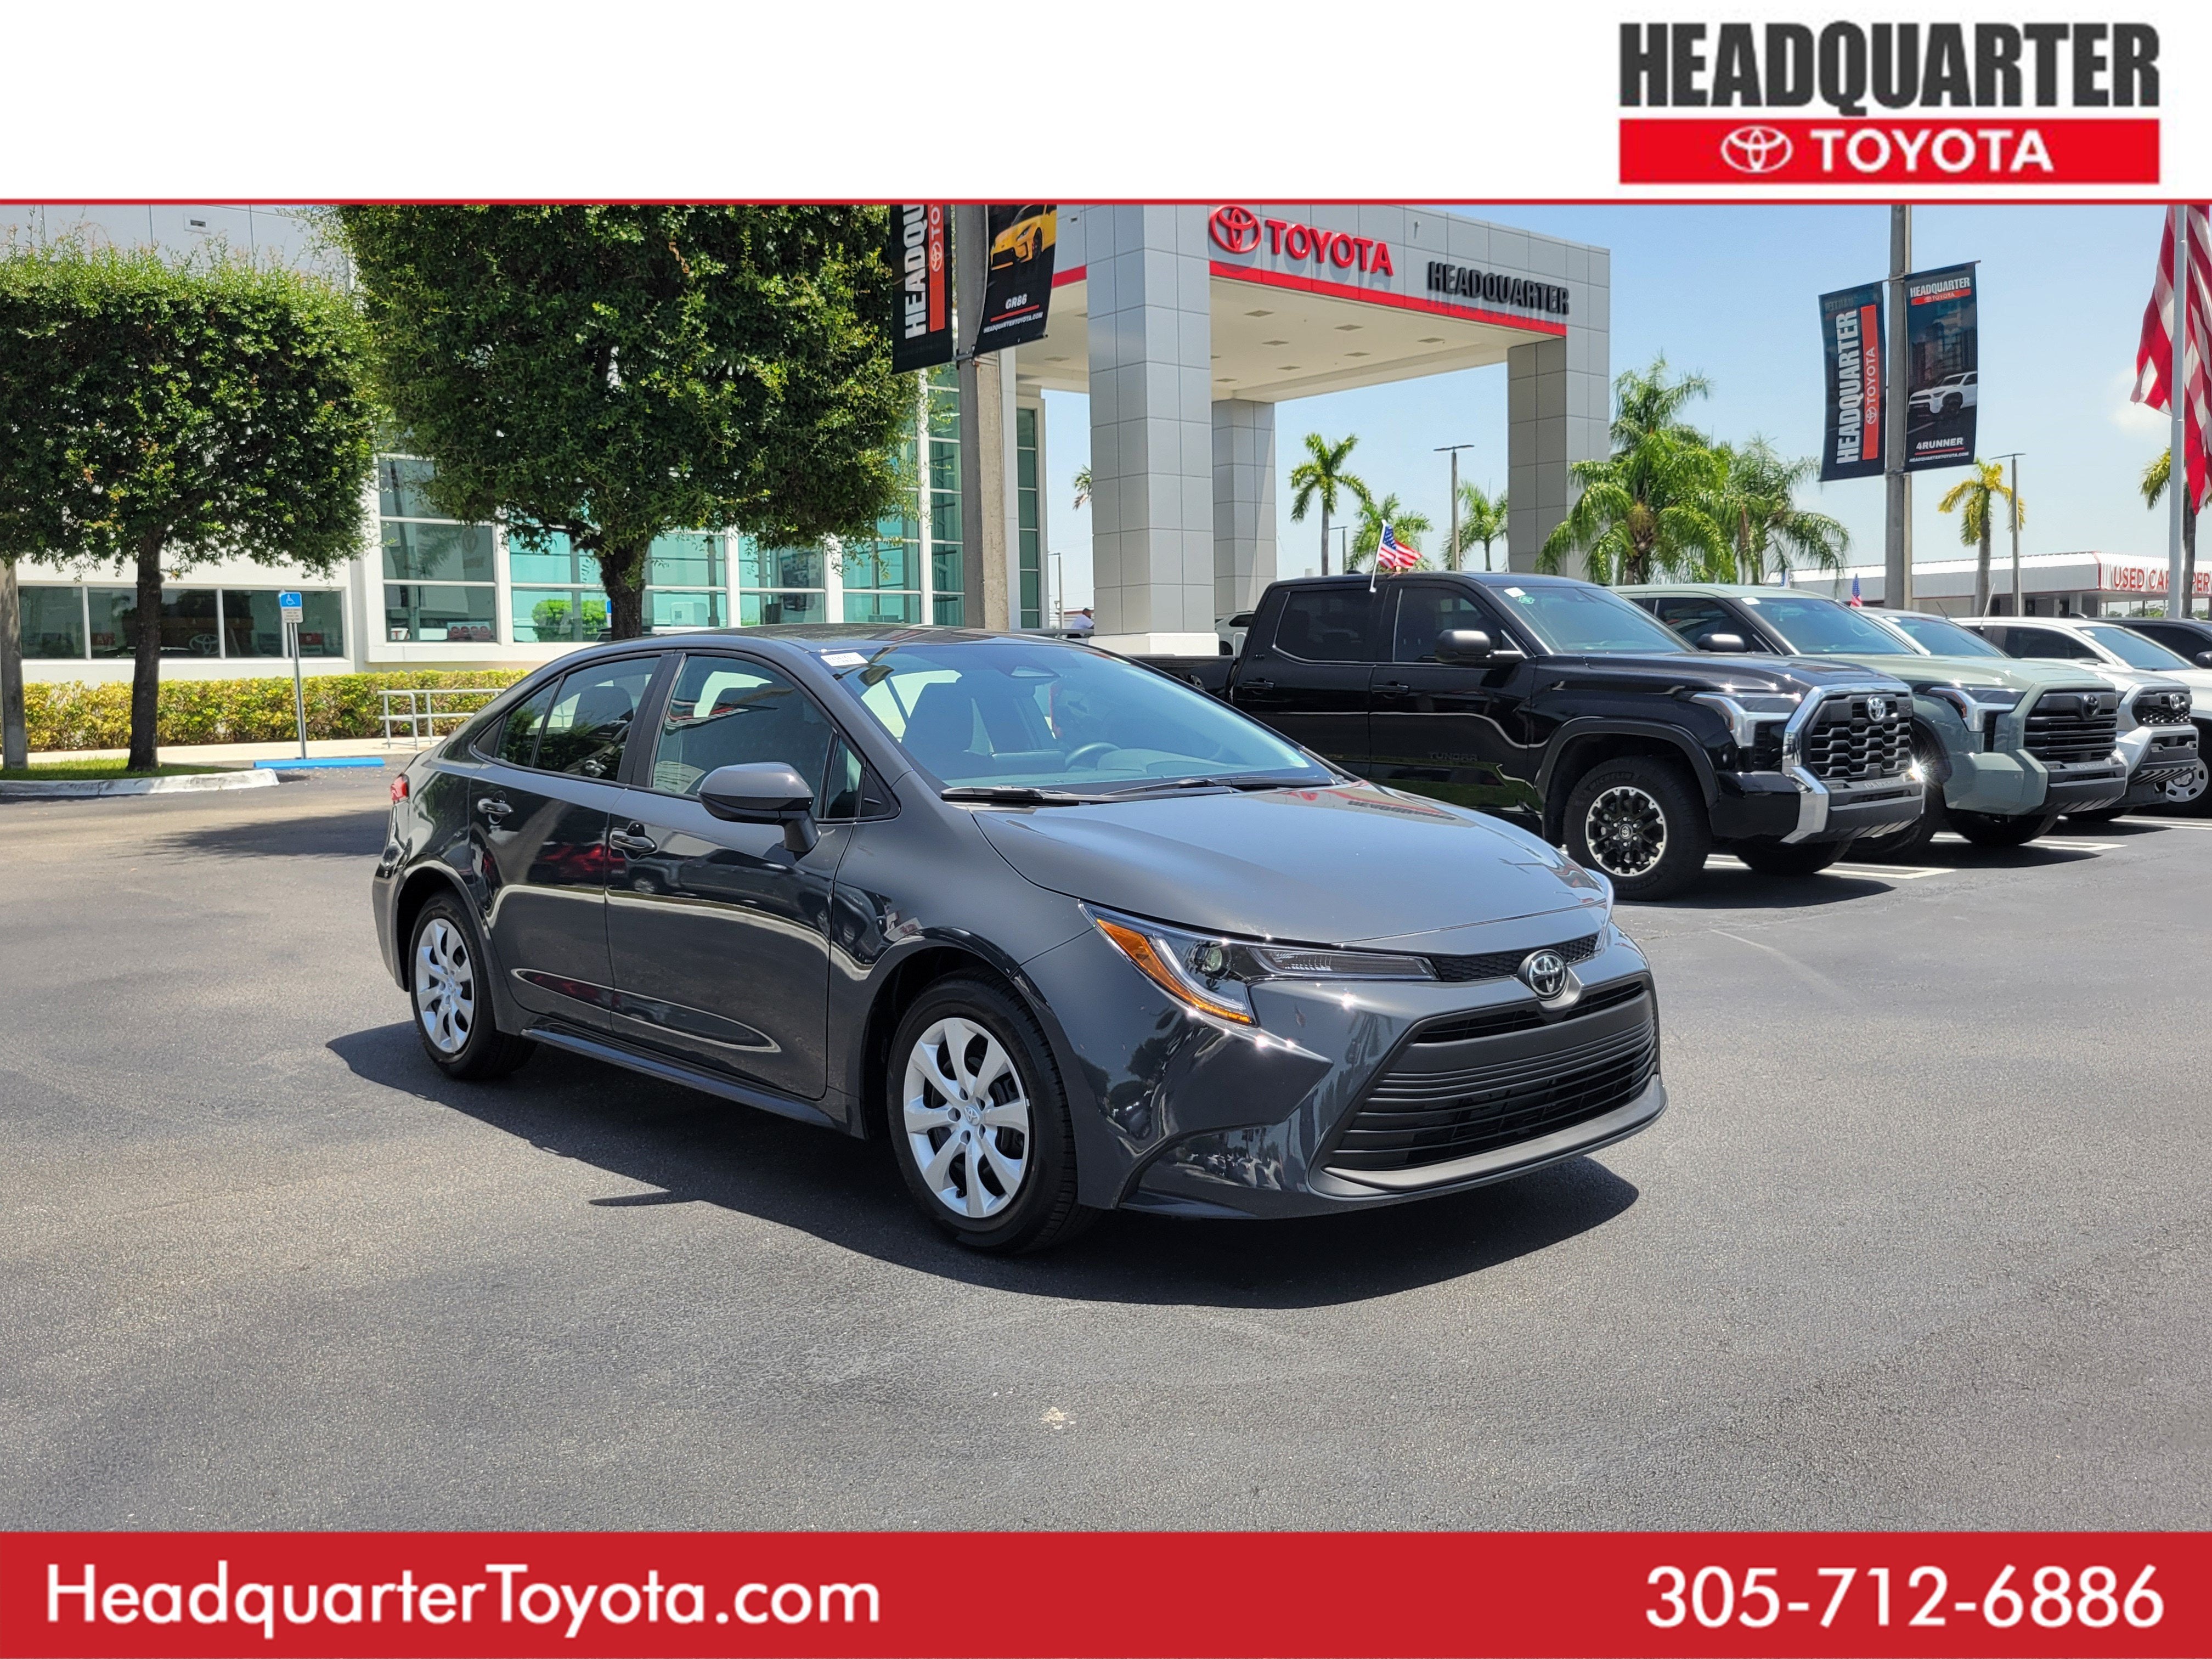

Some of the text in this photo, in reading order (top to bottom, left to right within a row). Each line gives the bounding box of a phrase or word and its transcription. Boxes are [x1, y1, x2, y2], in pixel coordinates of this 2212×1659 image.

[930, 205, 940, 241] TO
[1265, 219, 1394, 276] TOYOTA
[1427, 261, 1570, 315] HEADQUARTER
[1910, 276, 1971, 298] HEADQUARTER
[1932, 291, 1955, 300] TOYOTA
[983, 311, 1043, 334] HEADQUARTERTOYOTA.COM
[1836, 308, 1864, 465] HEADQUARTER
[1865, 347, 1876, 405] TOYOTA
[1916, 437, 1964, 450] 4RUNNER
[2114, 567, 2145, 589] USED
